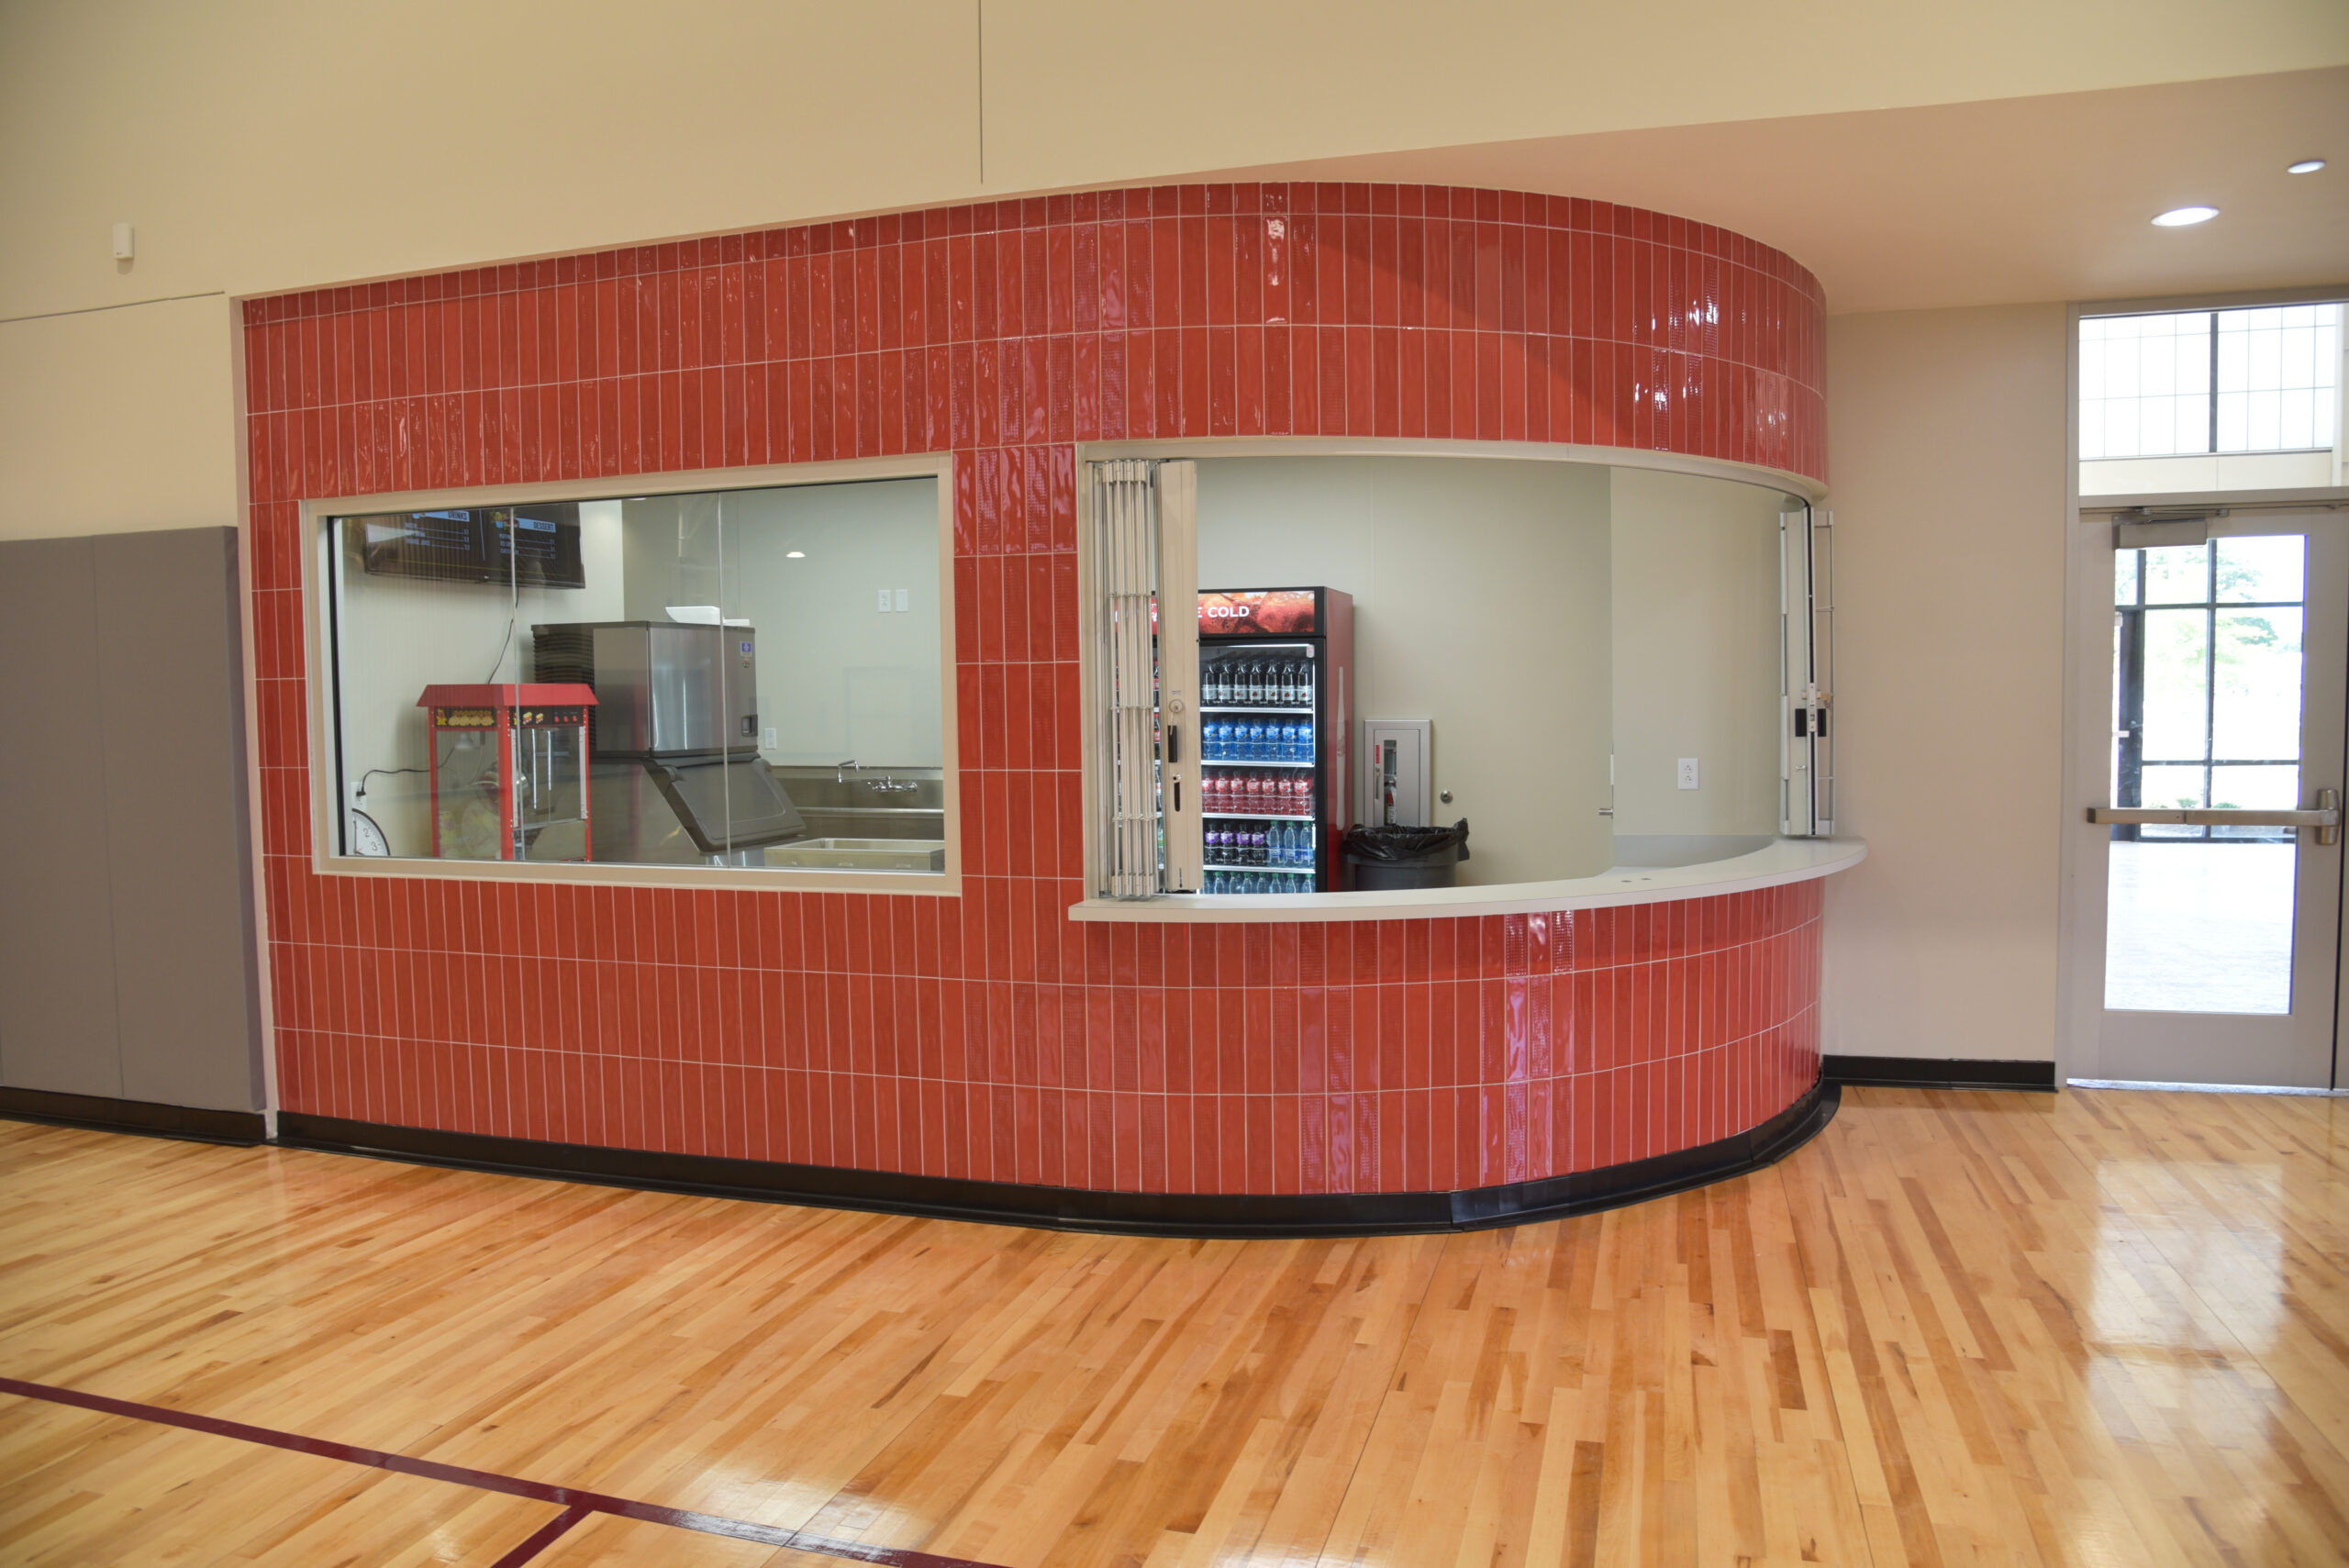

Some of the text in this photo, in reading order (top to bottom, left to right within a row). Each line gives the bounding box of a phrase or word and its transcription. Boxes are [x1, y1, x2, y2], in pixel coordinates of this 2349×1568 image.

[448, 511, 468, 520] DRINKS
[533, 521, 553, 530] DESSERT
[1208, 606, 1250, 618] COLD
[362, 828, 370, 837] 2
[371, 841, 378, 851] 3
